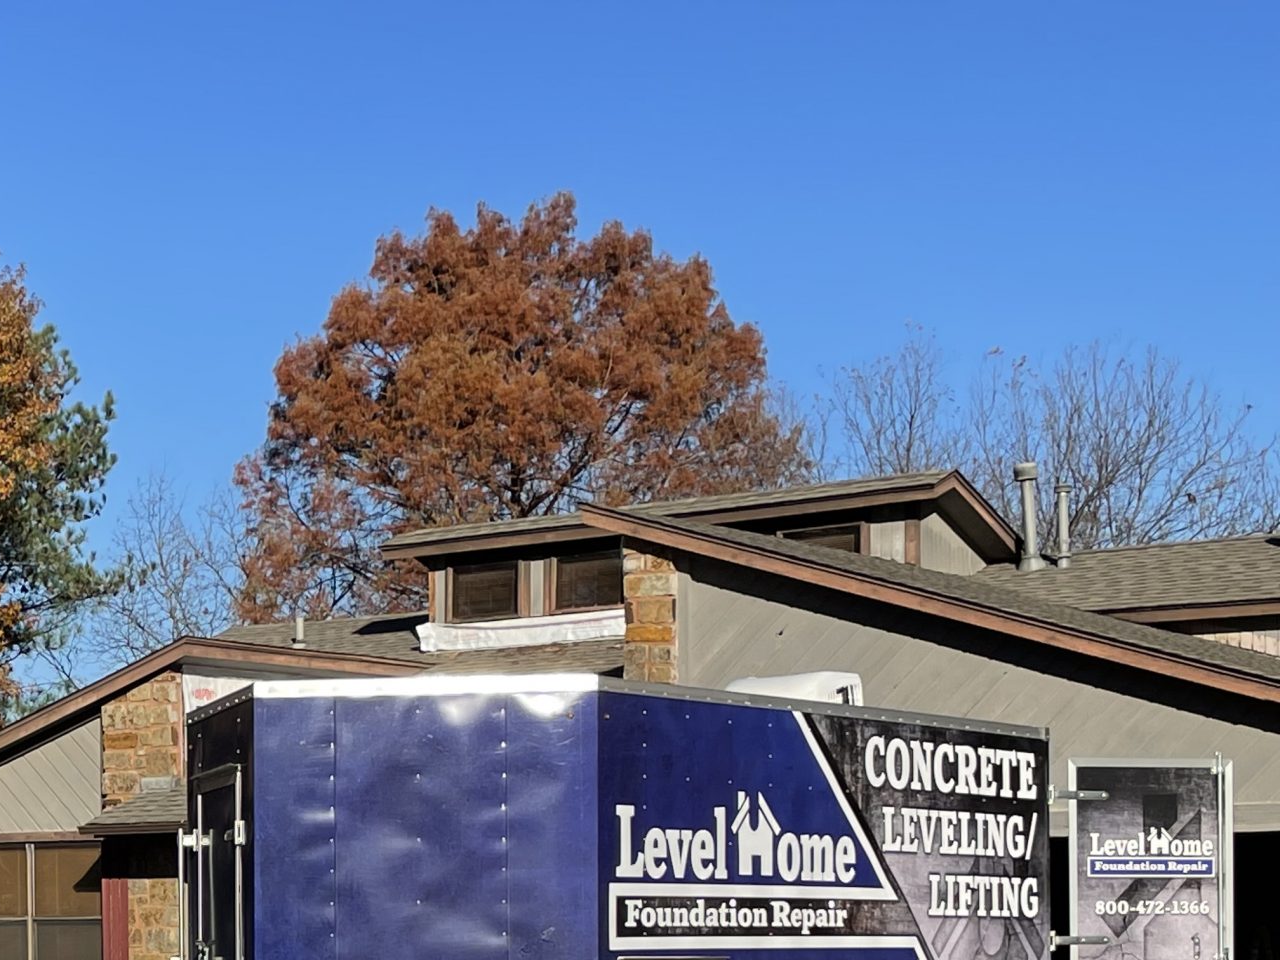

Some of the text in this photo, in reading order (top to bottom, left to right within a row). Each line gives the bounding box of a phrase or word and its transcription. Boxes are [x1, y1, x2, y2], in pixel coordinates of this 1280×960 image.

[865, 735, 1038, 800] CONCRETE
[615, 790, 857, 883] Level Home
[882, 806, 1038, 861] LEVELING/
[1090, 826, 1214, 856] Level Home
[1094, 861, 1209, 873] Foundation Repair
[624, 899, 848, 934] Foundation Repair
[928, 874, 1039, 919] LIFTING
[1095, 900, 1210, 915] 800-472-1366
